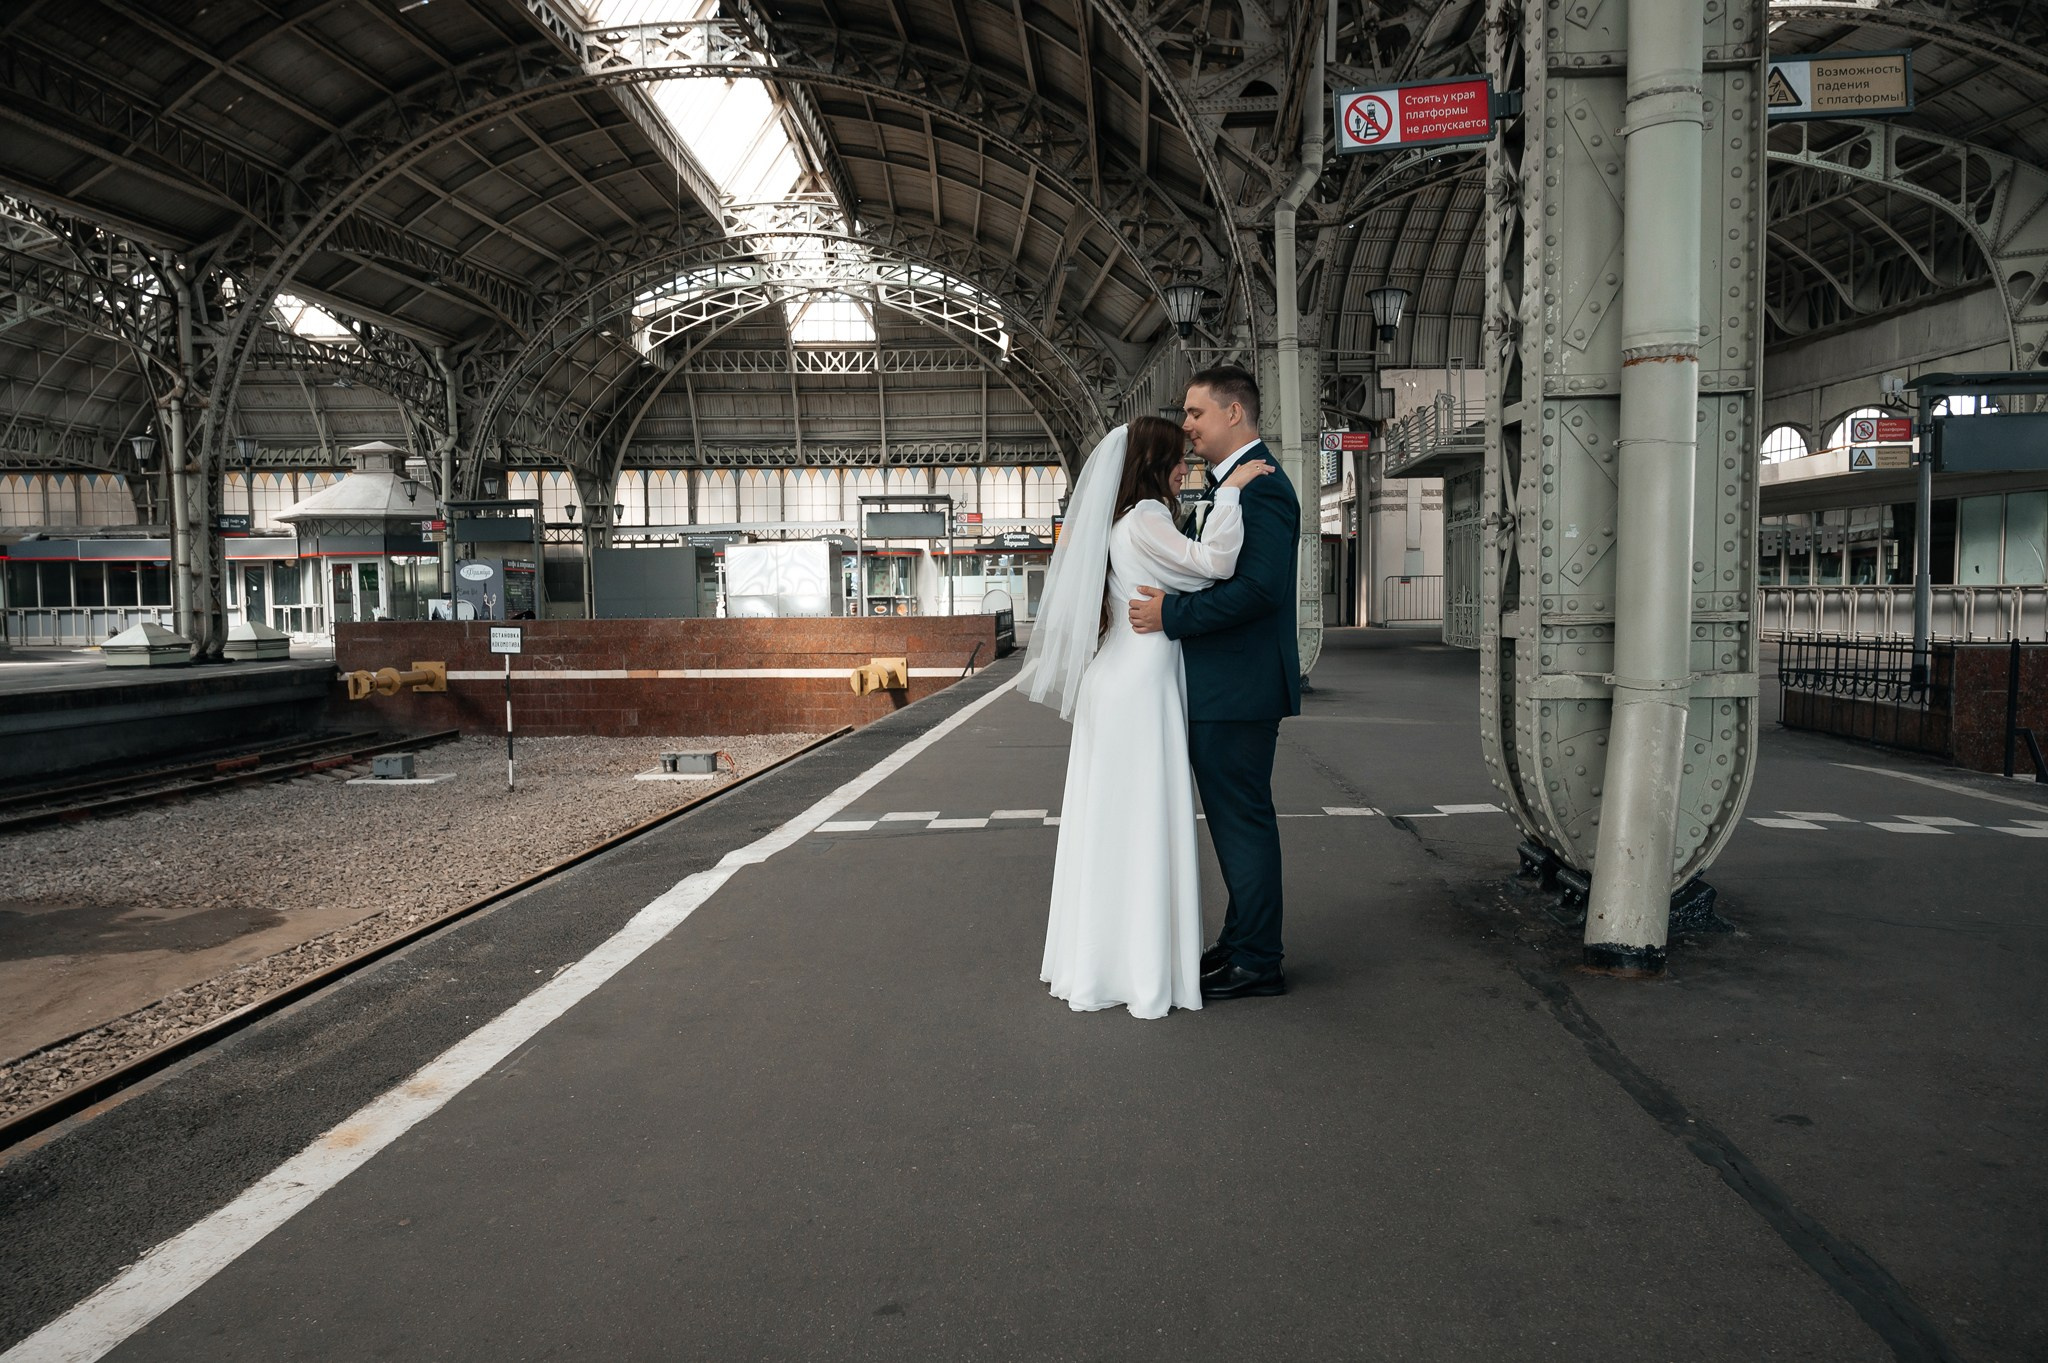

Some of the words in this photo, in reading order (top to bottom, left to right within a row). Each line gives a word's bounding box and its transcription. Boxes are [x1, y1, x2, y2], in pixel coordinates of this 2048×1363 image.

[1817, 65, 1902, 77] Возможность
[1817, 81, 1870, 93] падения
[1405, 94, 1441, 106] Стоять
[1443, 94, 1449, 105] у
[1451, 91, 1476, 102] края
[1817, 96, 1824, 105] с
[1826, 91, 1904, 106] платформы!
[1405, 107, 1469, 121] платформы
[1406, 124, 1420, 134] не
[1421, 119, 1487, 134] допускается
